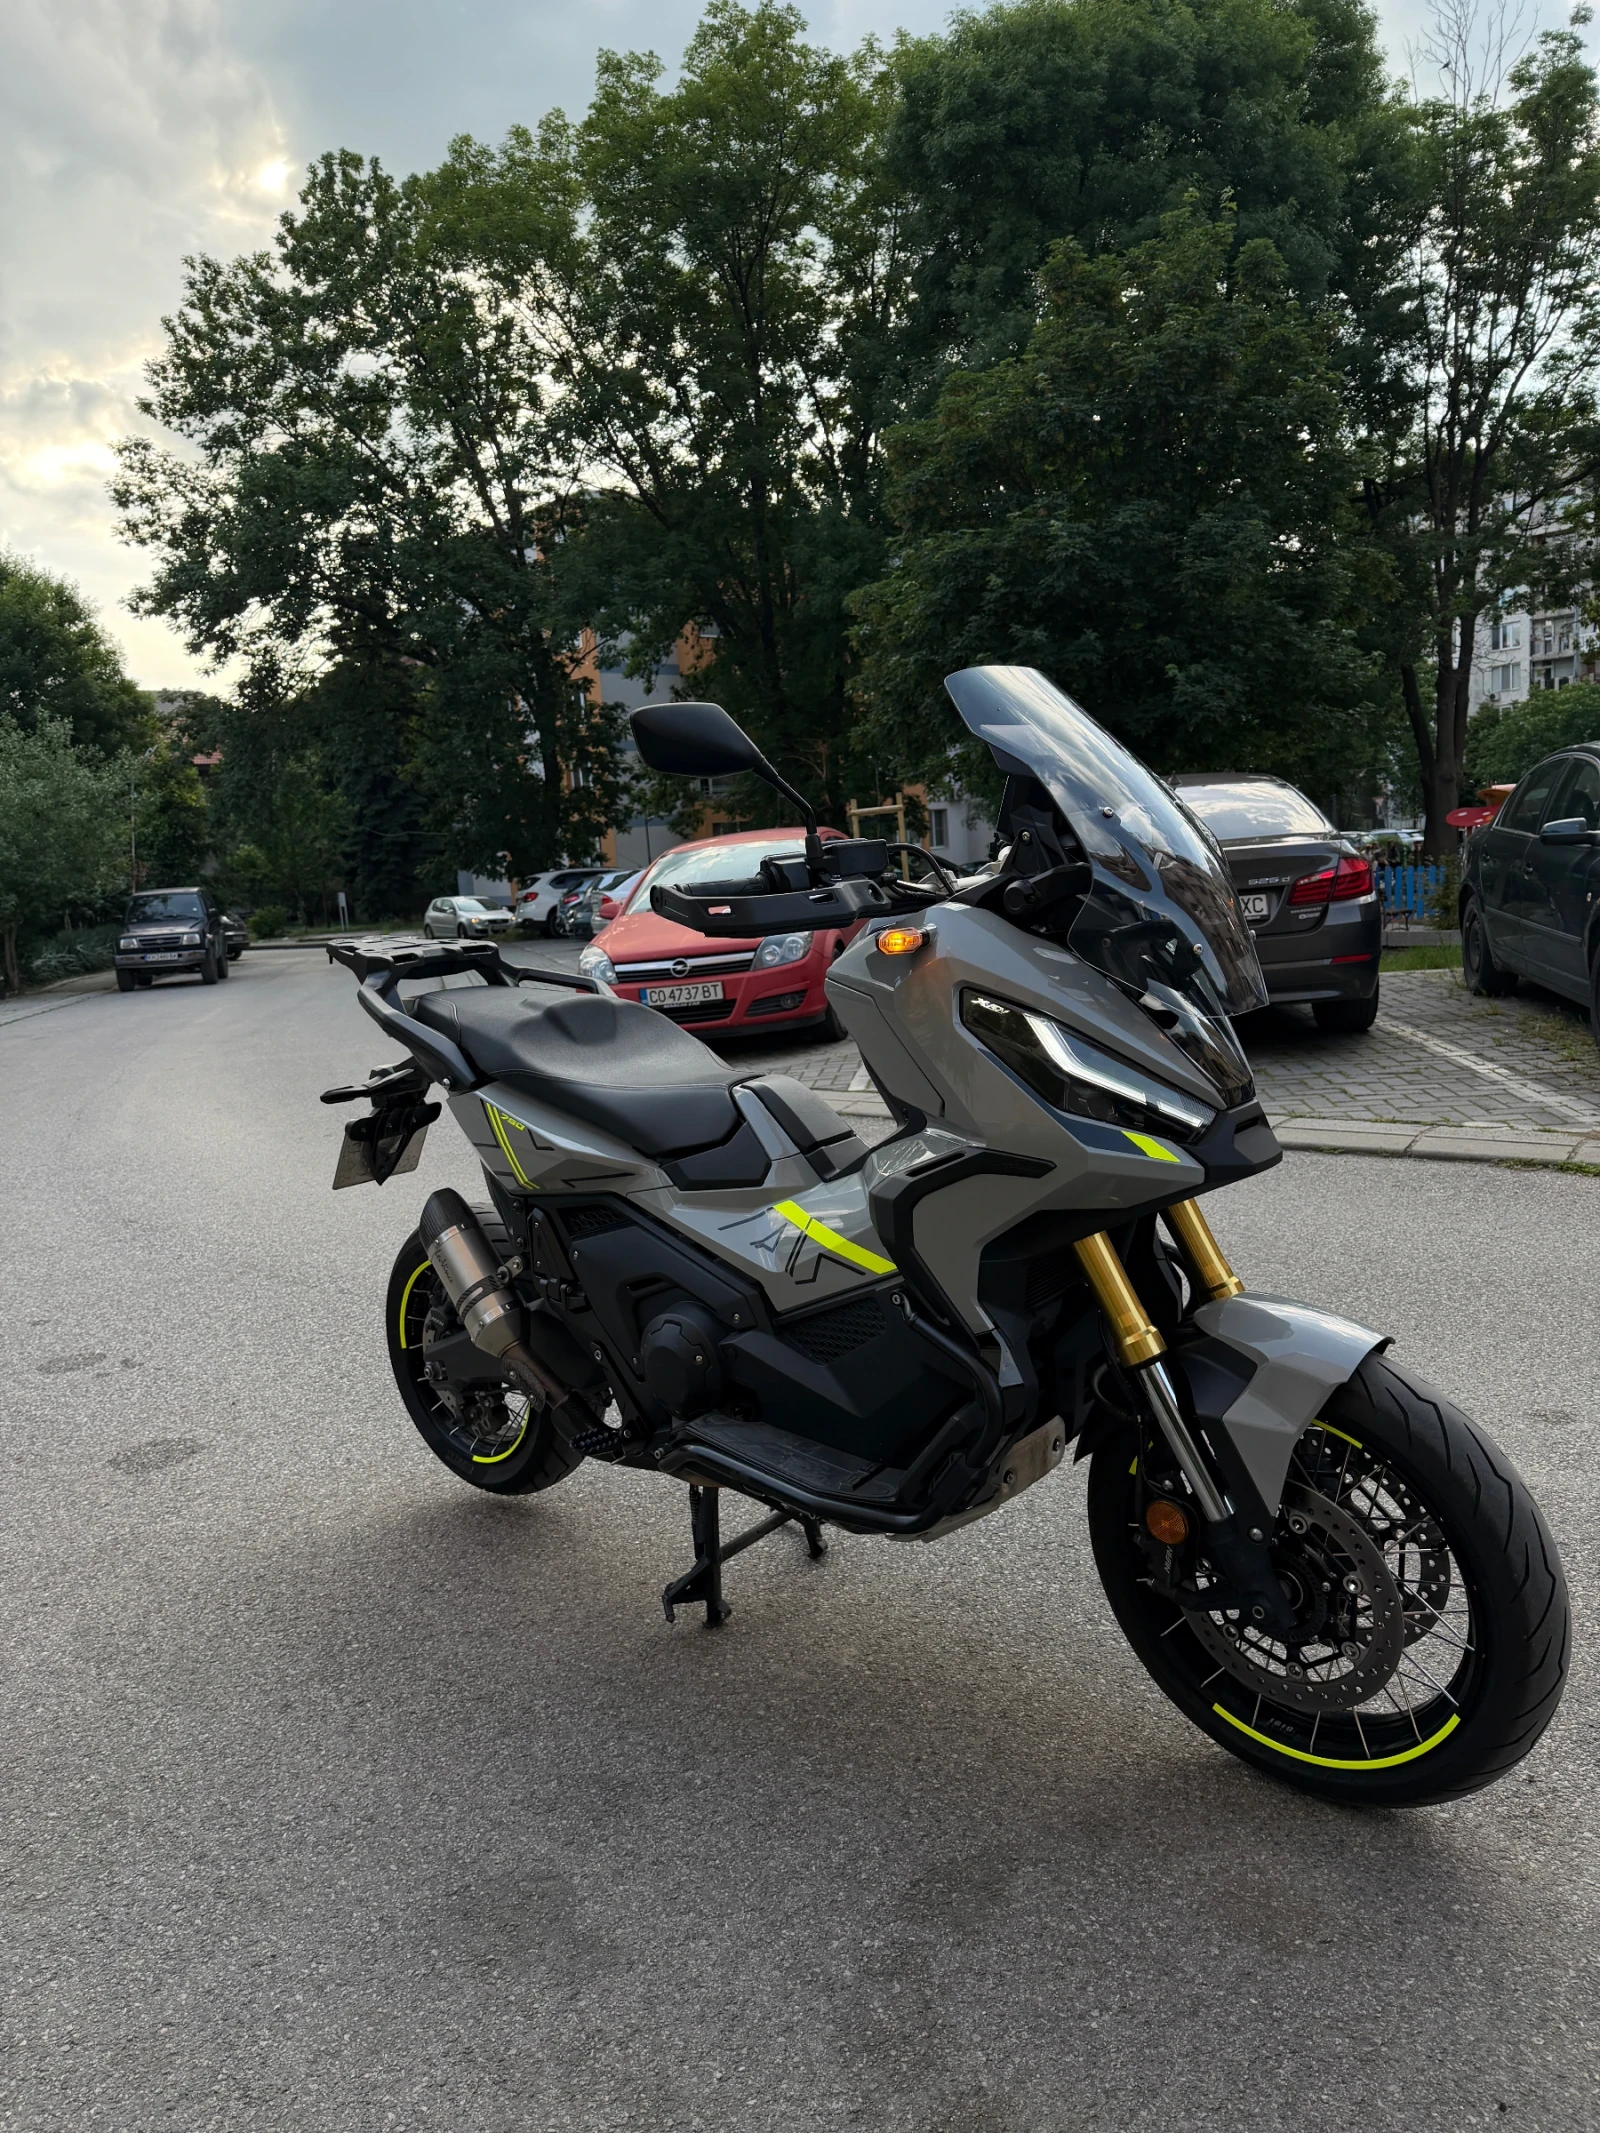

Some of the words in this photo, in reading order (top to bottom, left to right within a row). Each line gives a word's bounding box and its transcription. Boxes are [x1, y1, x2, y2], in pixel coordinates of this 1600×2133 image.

[669, 986, 699, 1001] 4737
[702, 984, 719, 999] BT
[500, 1112, 525, 1131] 750
